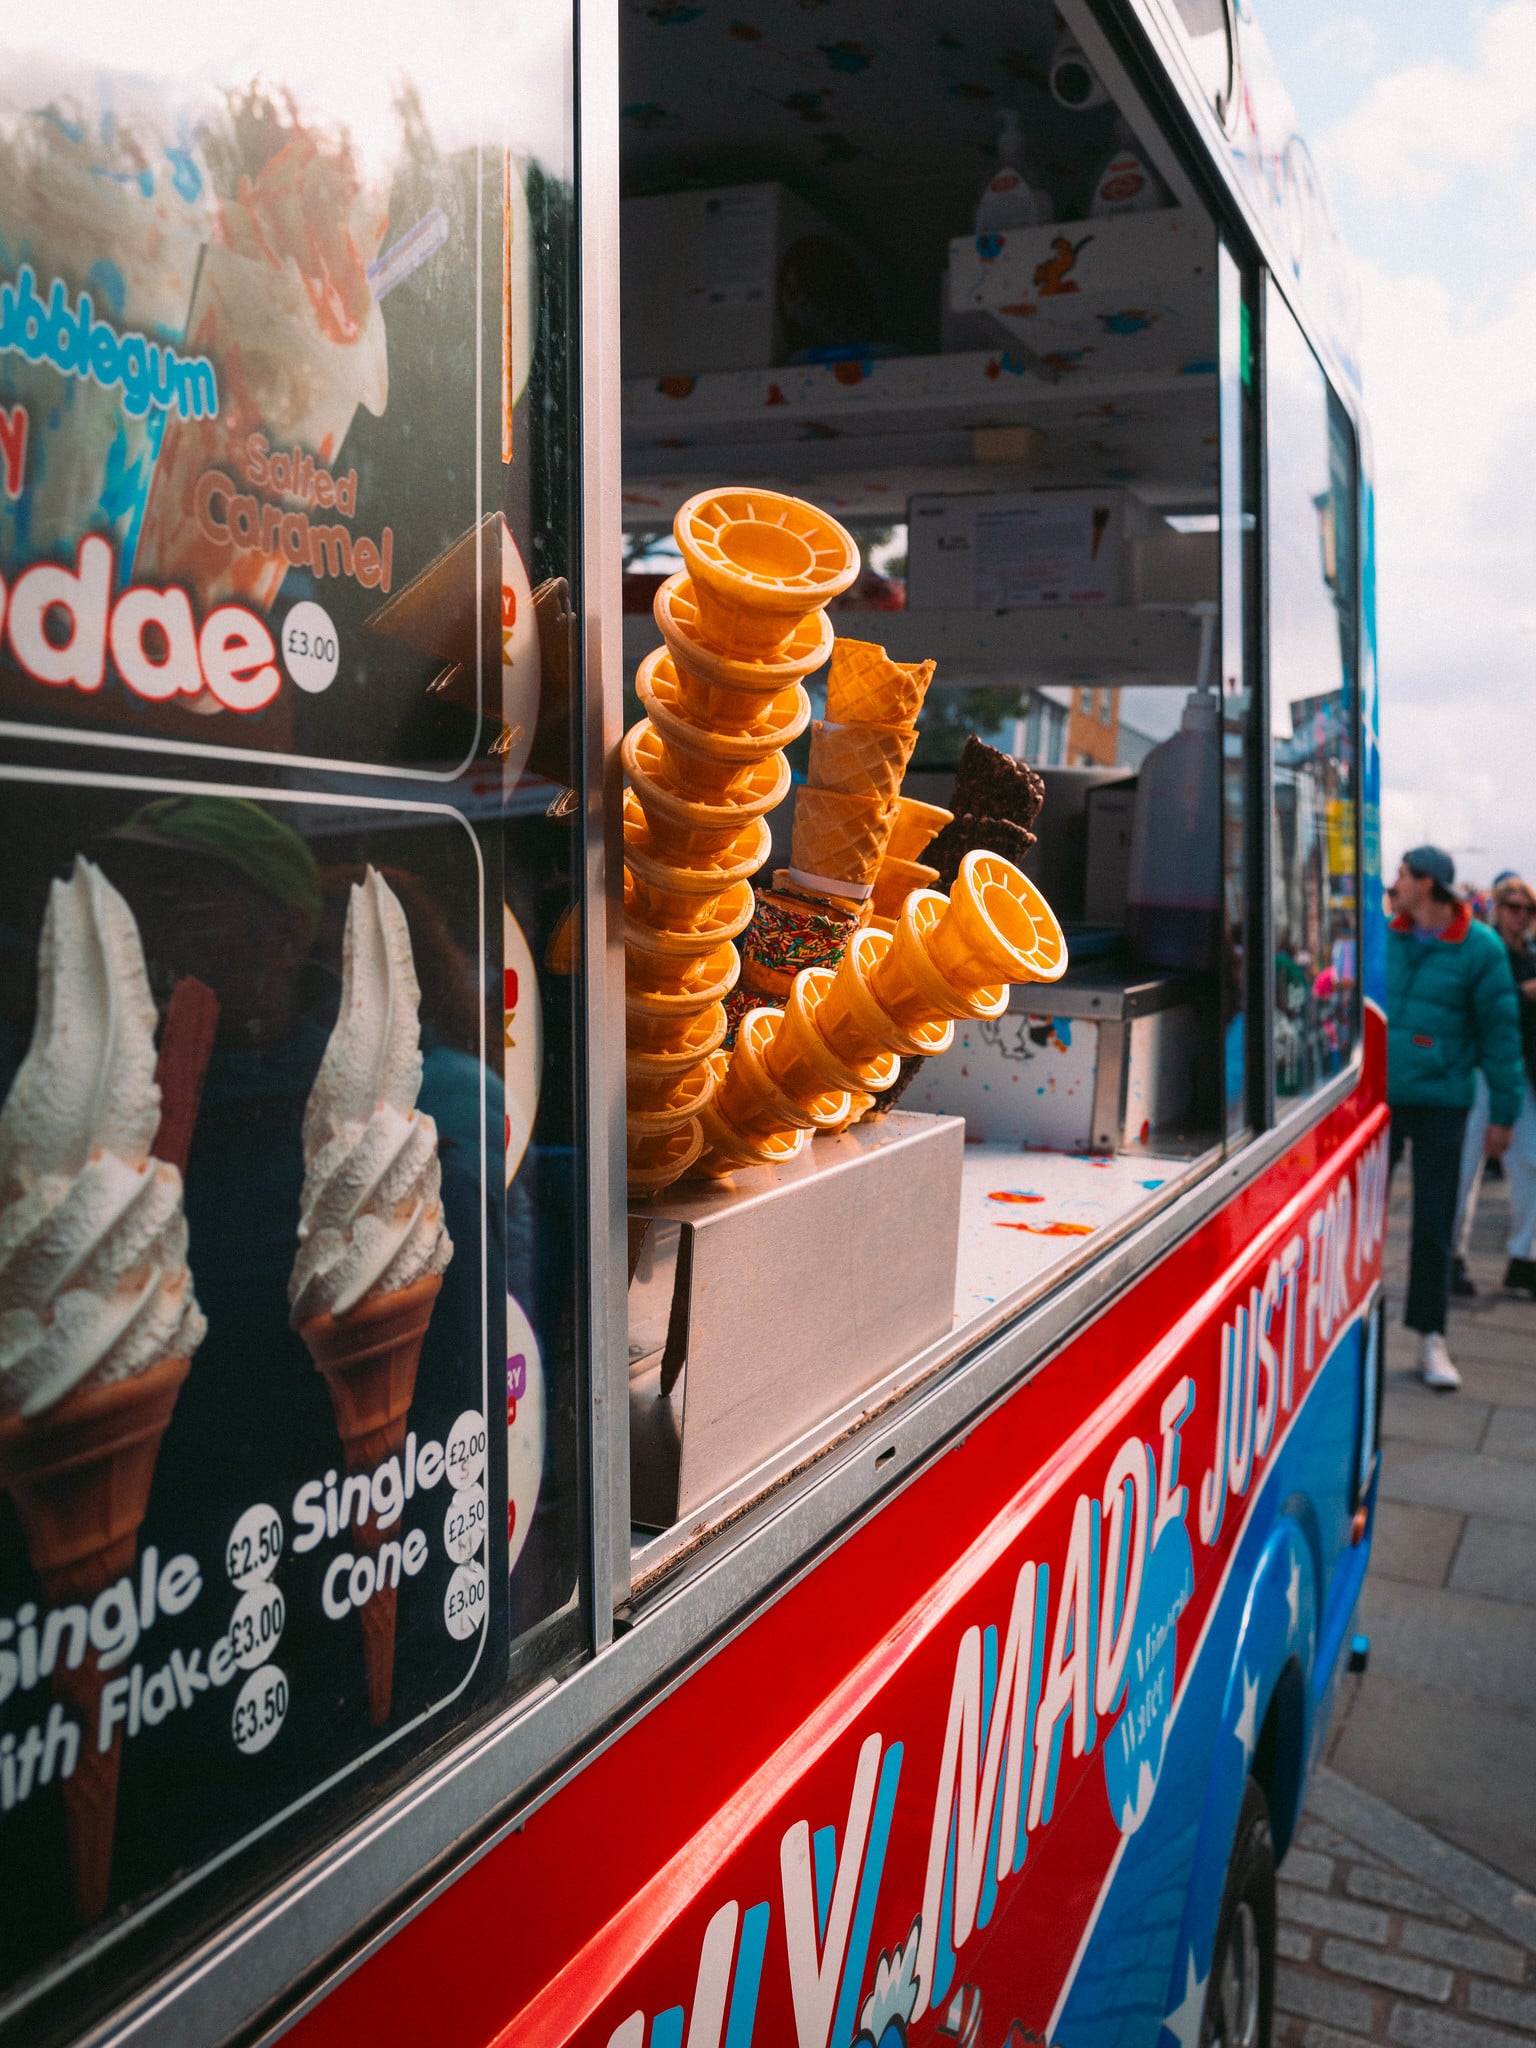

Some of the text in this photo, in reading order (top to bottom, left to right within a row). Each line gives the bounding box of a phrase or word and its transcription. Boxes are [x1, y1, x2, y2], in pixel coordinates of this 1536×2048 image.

[247, 433, 357, 518] Salted
[195, 470, 393, 593] Caramel
[0, 531, 282, 714] dae
[289, 630, 336, 662] £3.00
[449, 1431, 486, 1466] £2.00
[292, 1431, 446, 1554] Single
[448, 1500, 484, 1543] £2.50
[229, 1520, 281, 1580] £2.50
[321, 1528, 430, 1620] Cone
[231, 1599, 282, 1659] £3.00
[448, 1580, 484, 1618] £3.00
[909, 1375, 1196, 2024] MADE
[1200, 1235, 1303, 1546] JUST
[1305, 1173, 1351, 1371] FOR
[97, 1636, 238, 1754] Flake
[235, 1680, 286, 1744] £3.50
